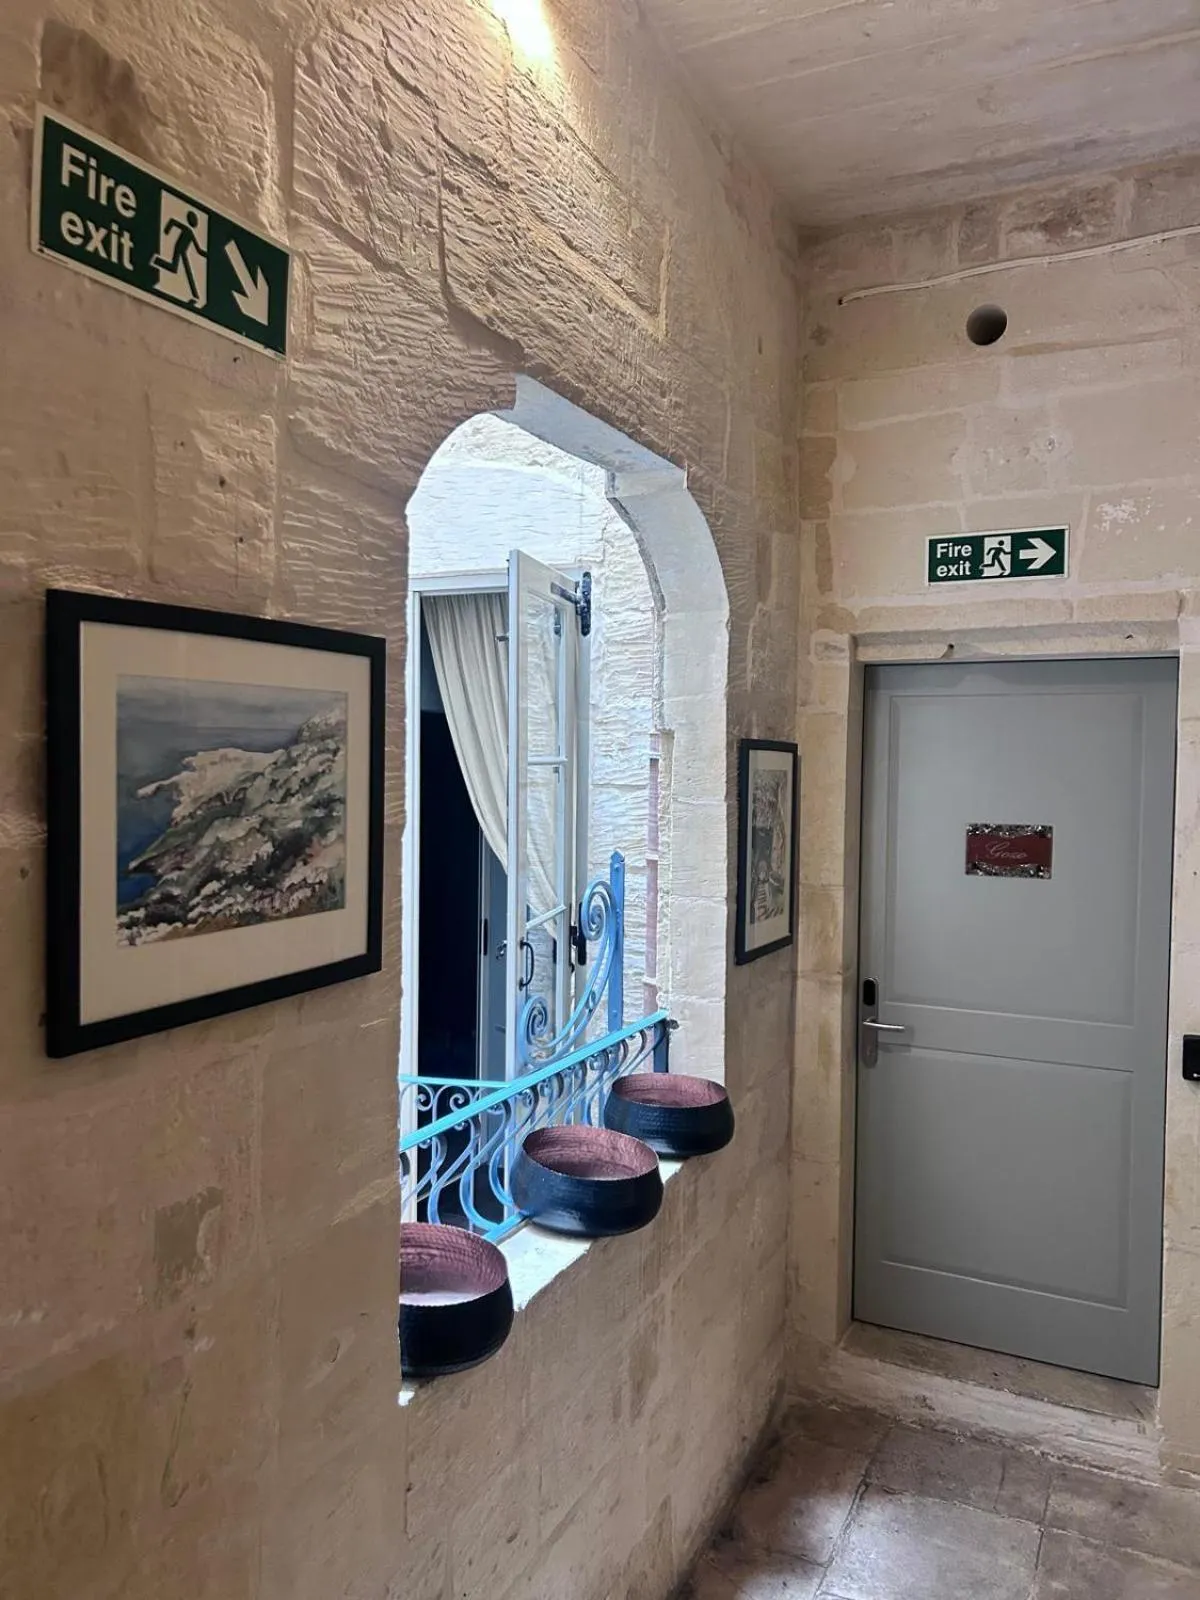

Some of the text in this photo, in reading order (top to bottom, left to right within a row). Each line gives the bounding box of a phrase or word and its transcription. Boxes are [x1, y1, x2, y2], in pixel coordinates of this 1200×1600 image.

[61, 143, 137, 218] Fire
[60, 211, 134, 271] exit
[936, 543, 972, 558] Fire
[936, 561, 971, 577] exit
